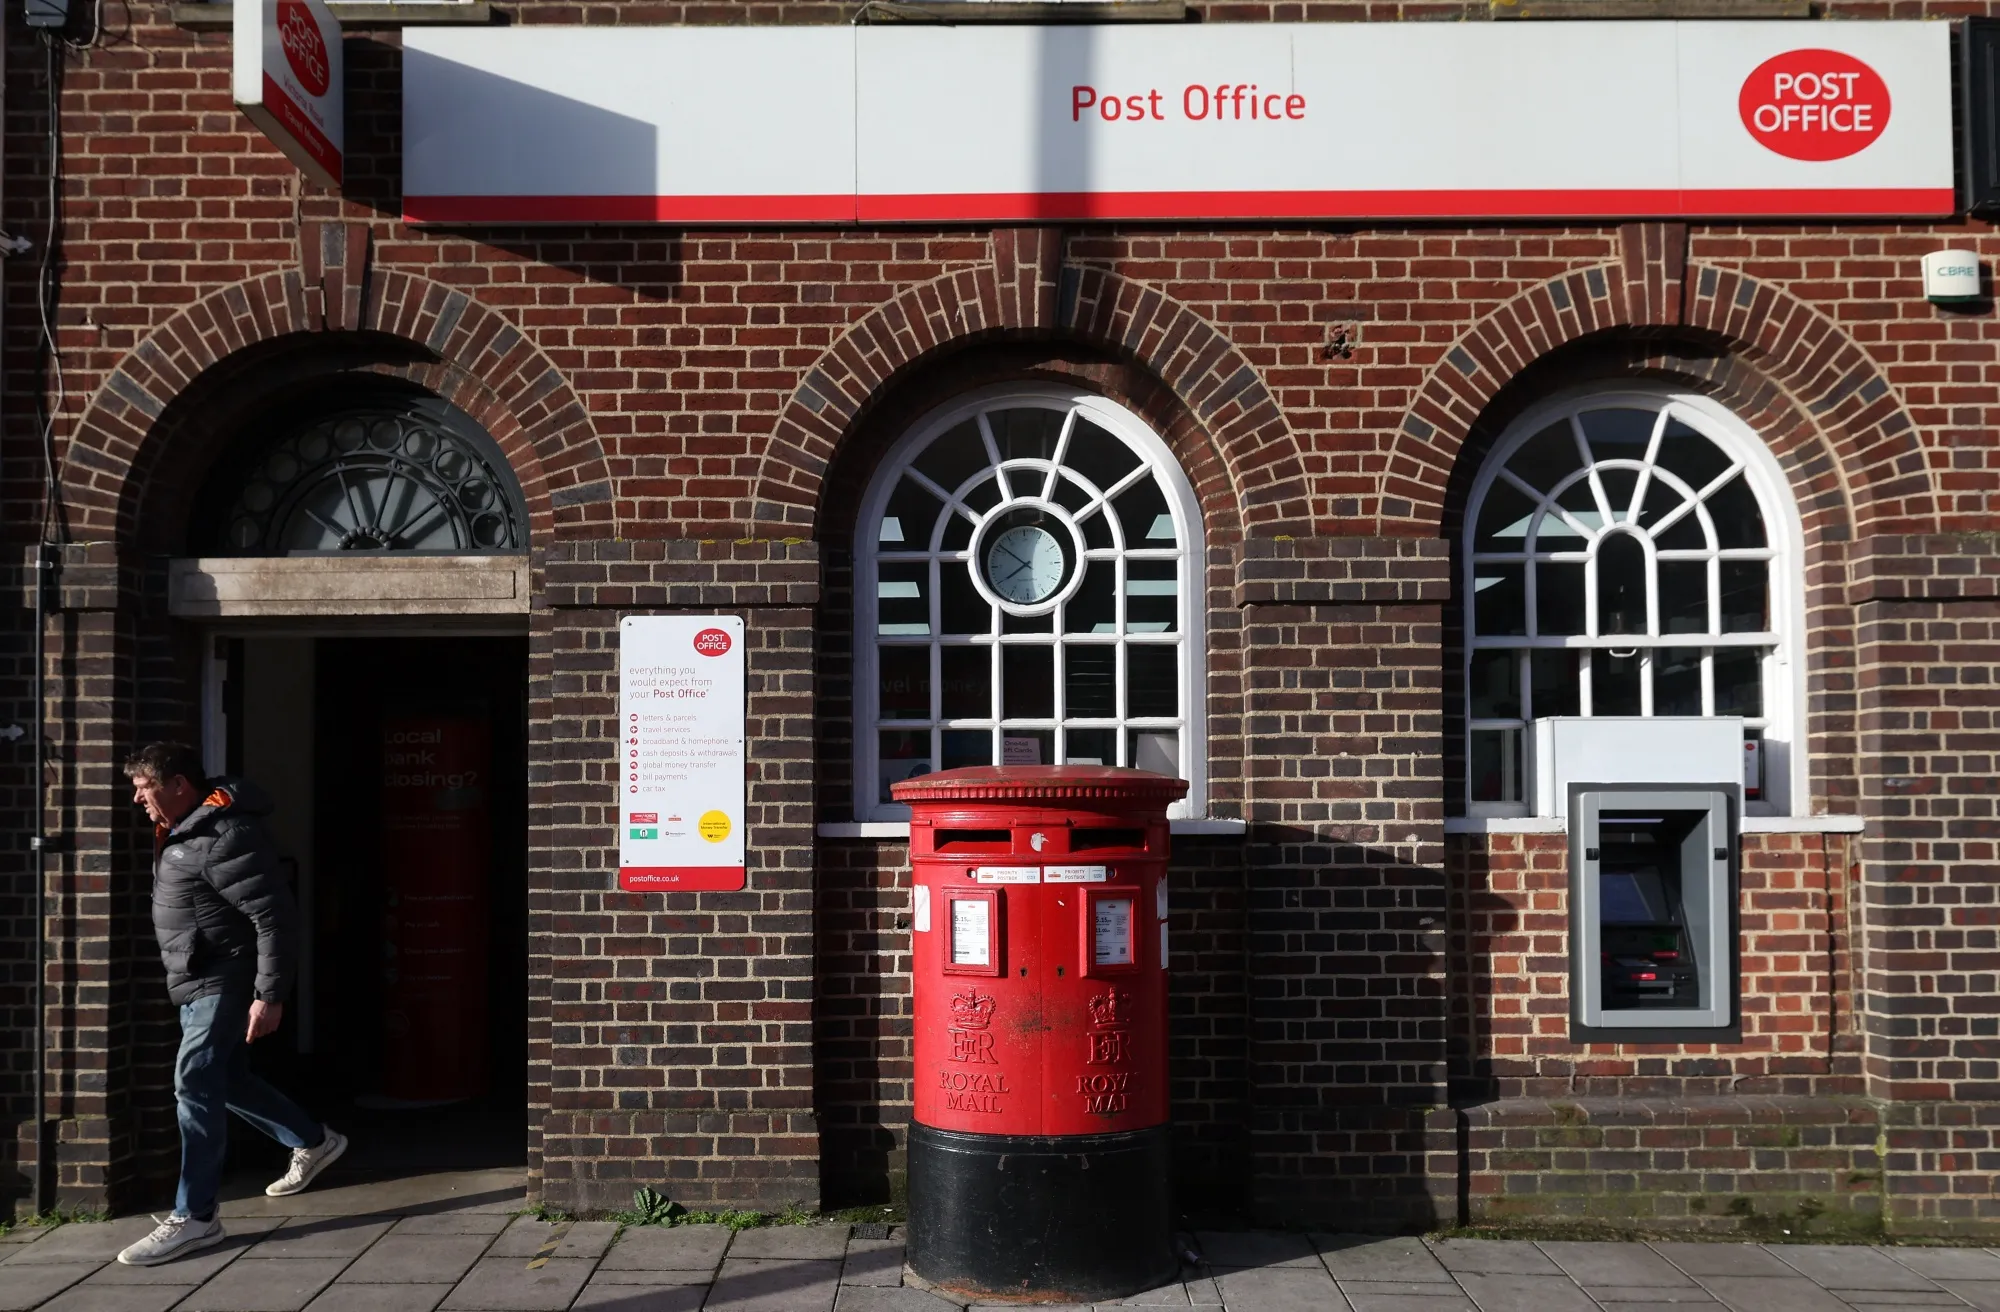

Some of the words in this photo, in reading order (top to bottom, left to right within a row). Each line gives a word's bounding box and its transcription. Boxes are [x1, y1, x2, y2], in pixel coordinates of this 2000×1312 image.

[290, 6, 320, 55] POST
[282, 23, 324, 86] OFFICE
[1774, 72, 1860, 100] POST
[1072, 86, 1164, 122] Post
[1183, 84, 1306, 120] Office
[284, 104, 303, 133] Travel
[1754, 104, 1873, 132] OFFICE
[1937, 266, 1976, 276] CBRE
[630, 666, 677, 676] everything
[680, 667, 696, 676] you
[630, 678, 656, 686] would
[660, 678, 688, 688] expect
[691, 678, 712, 686] from
[630, 690, 650, 700] your
[654, 689, 675, 698] Post
[673, 714, 697, 722] parcels
[384, 728, 442, 744] Local
[688, 738, 728, 746] homephone
[384, 750, 436, 765] bank
[642, 761, 662, 770] global
[384, 770, 478, 791] closing?
[939, 1070, 1010, 1094] ROYAL
[946, 1092, 1002, 1114] MAIL
